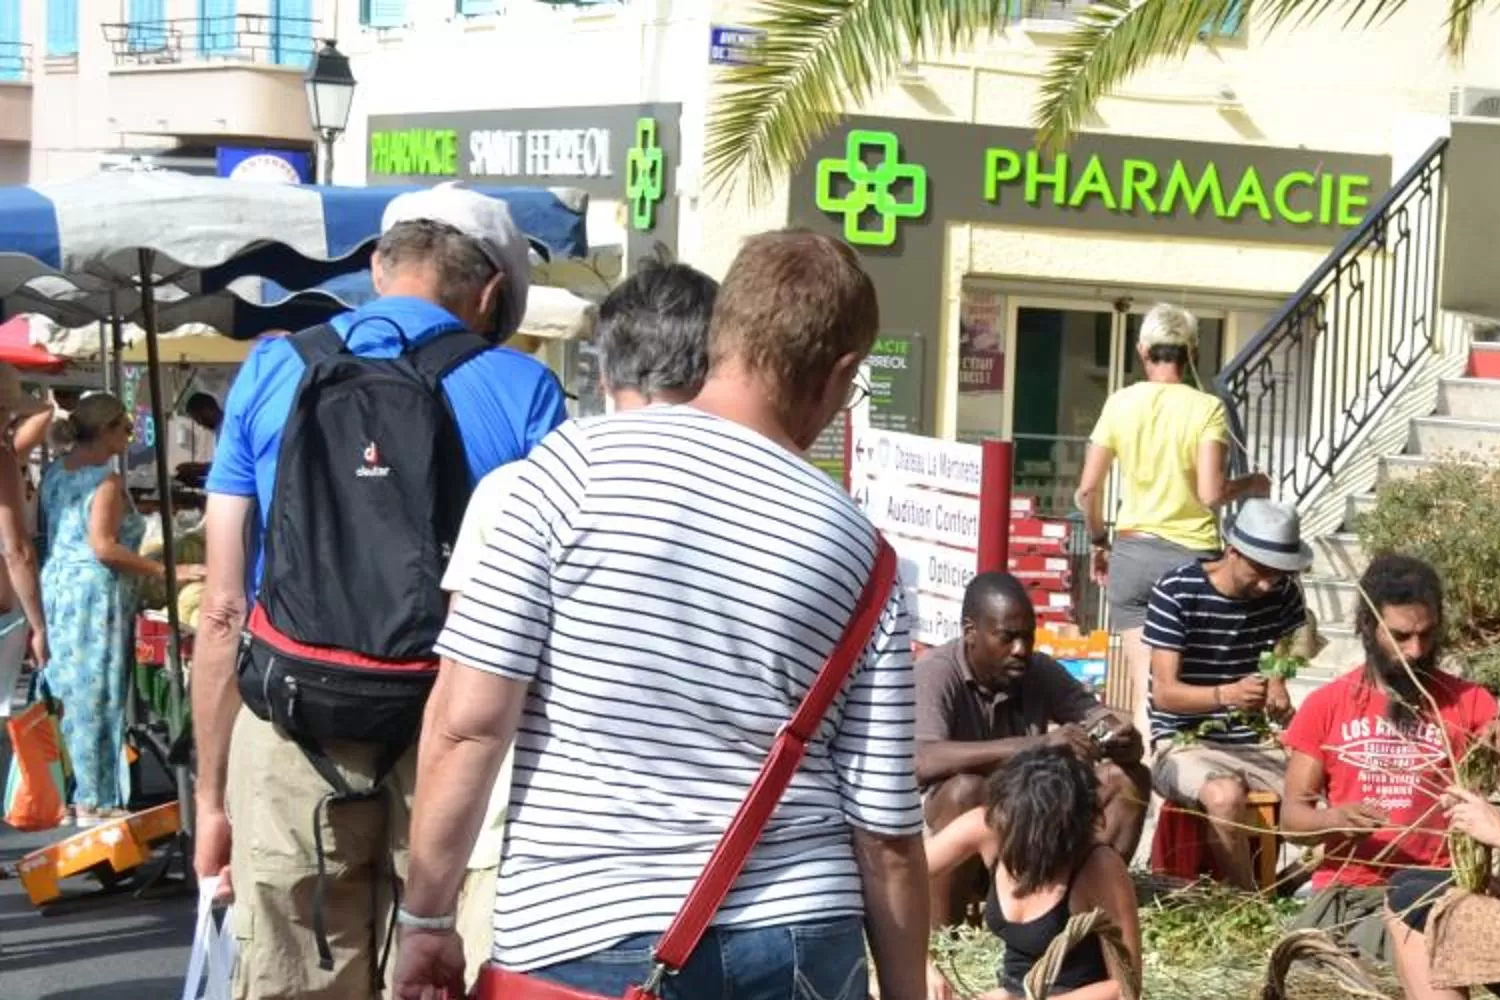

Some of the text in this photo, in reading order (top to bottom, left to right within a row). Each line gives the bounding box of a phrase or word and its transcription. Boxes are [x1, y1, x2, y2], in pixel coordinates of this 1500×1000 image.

[371, 128, 457, 176] PHARMACIE
[469, 129, 522, 176] SAINT
[984, 147, 1370, 226] PHARMACIE
[887, 495, 978, 536] Audition Confort
[1341, 717, 1371, 742] LOS
